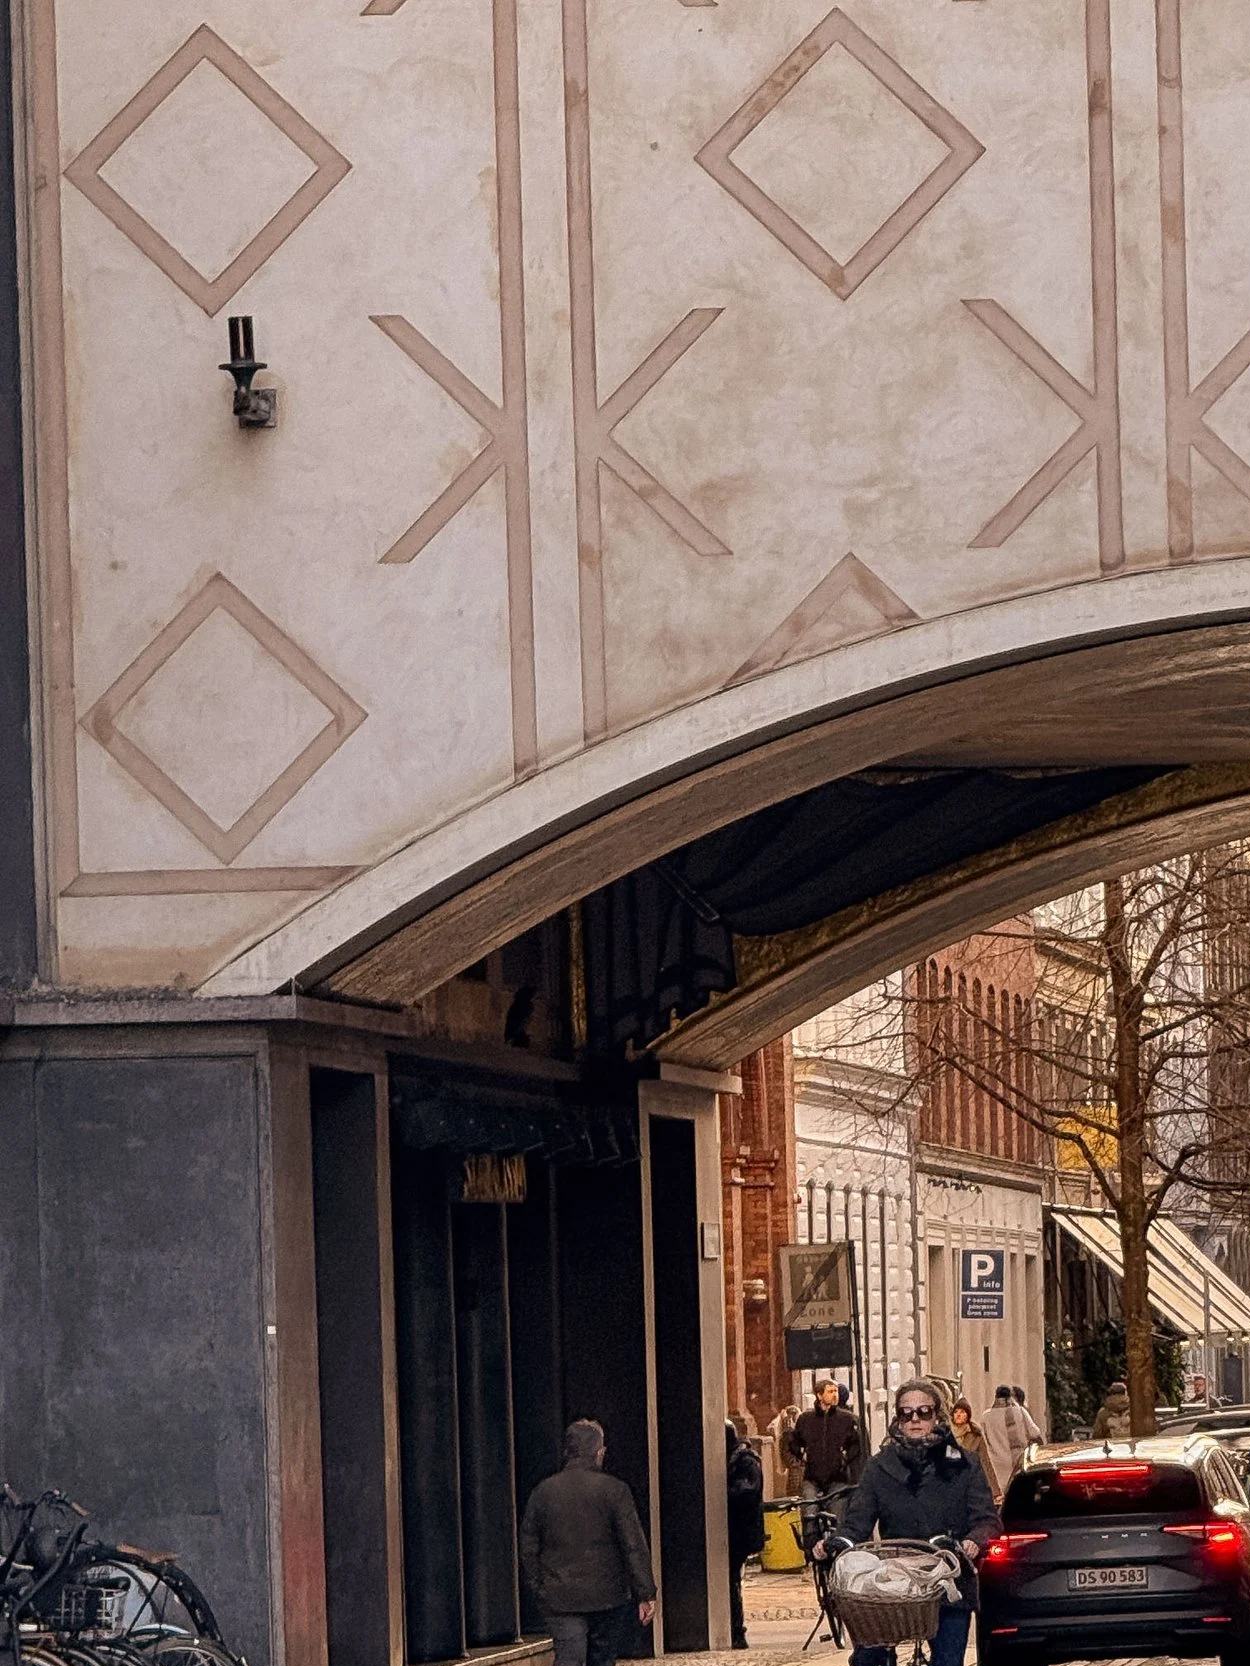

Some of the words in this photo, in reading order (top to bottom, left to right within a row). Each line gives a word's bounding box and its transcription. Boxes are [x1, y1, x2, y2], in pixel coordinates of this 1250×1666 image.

[971, 1254, 995, 1288] P
[983, 1281, 1001, 1289] info
[1078, 1571, 1098, 1585] DS
[1100, 1570, 1116, 1583] 90
[1119, 1569, 1144, 1582] 583
